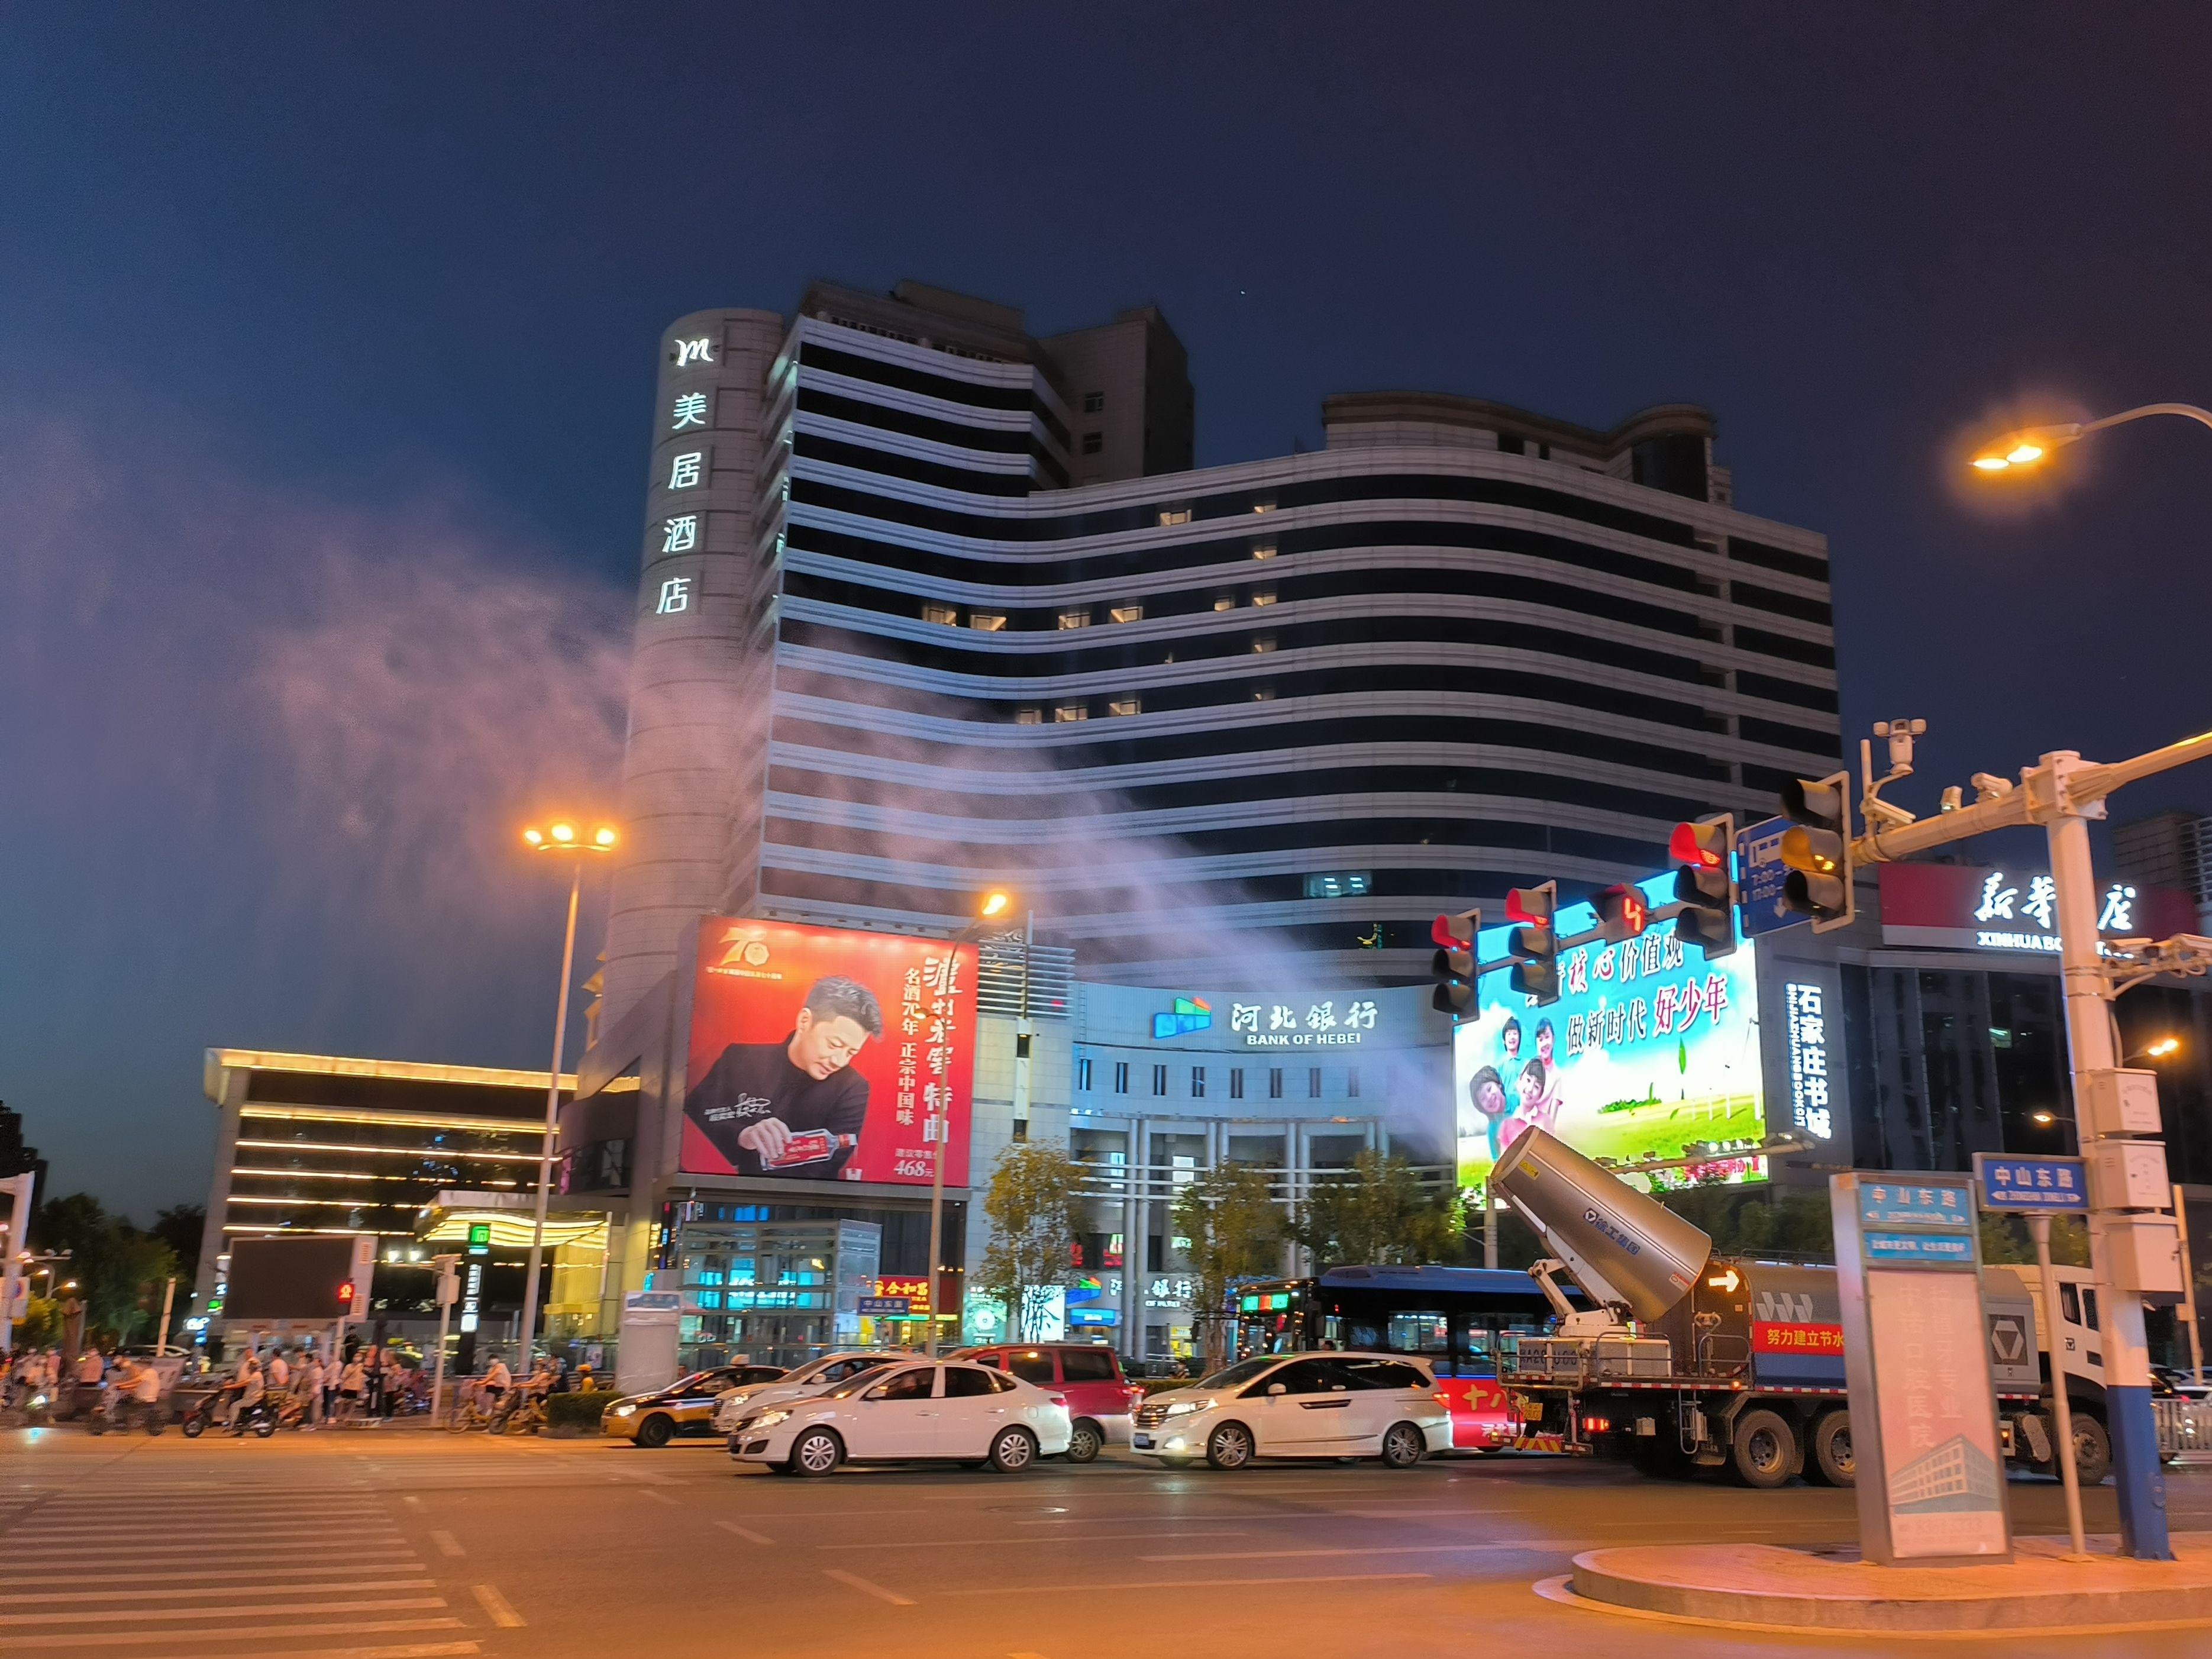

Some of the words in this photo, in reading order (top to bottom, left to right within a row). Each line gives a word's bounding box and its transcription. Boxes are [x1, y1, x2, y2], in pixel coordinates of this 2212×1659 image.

[655, 392, 706, 614] 美居酒店
[1232, 1000, 1378, 1032] 河北银行
[1568, 975, 1727, 1054] 做新时代好少年
[1247, 1034, 1290, 1045] BANK
[1292, 1034, 1313, 1045] OF
[1316, 1032, 1361, 1044] HEBEI
[896, 1042, 918, 1126] 正宗中国味
[1994, 1166, 2073, 1189] 中山东路
[1872, 1186, 1956, 1208] 中山东路
[1767, 1328, 1844, 1347] 努力建立节水
